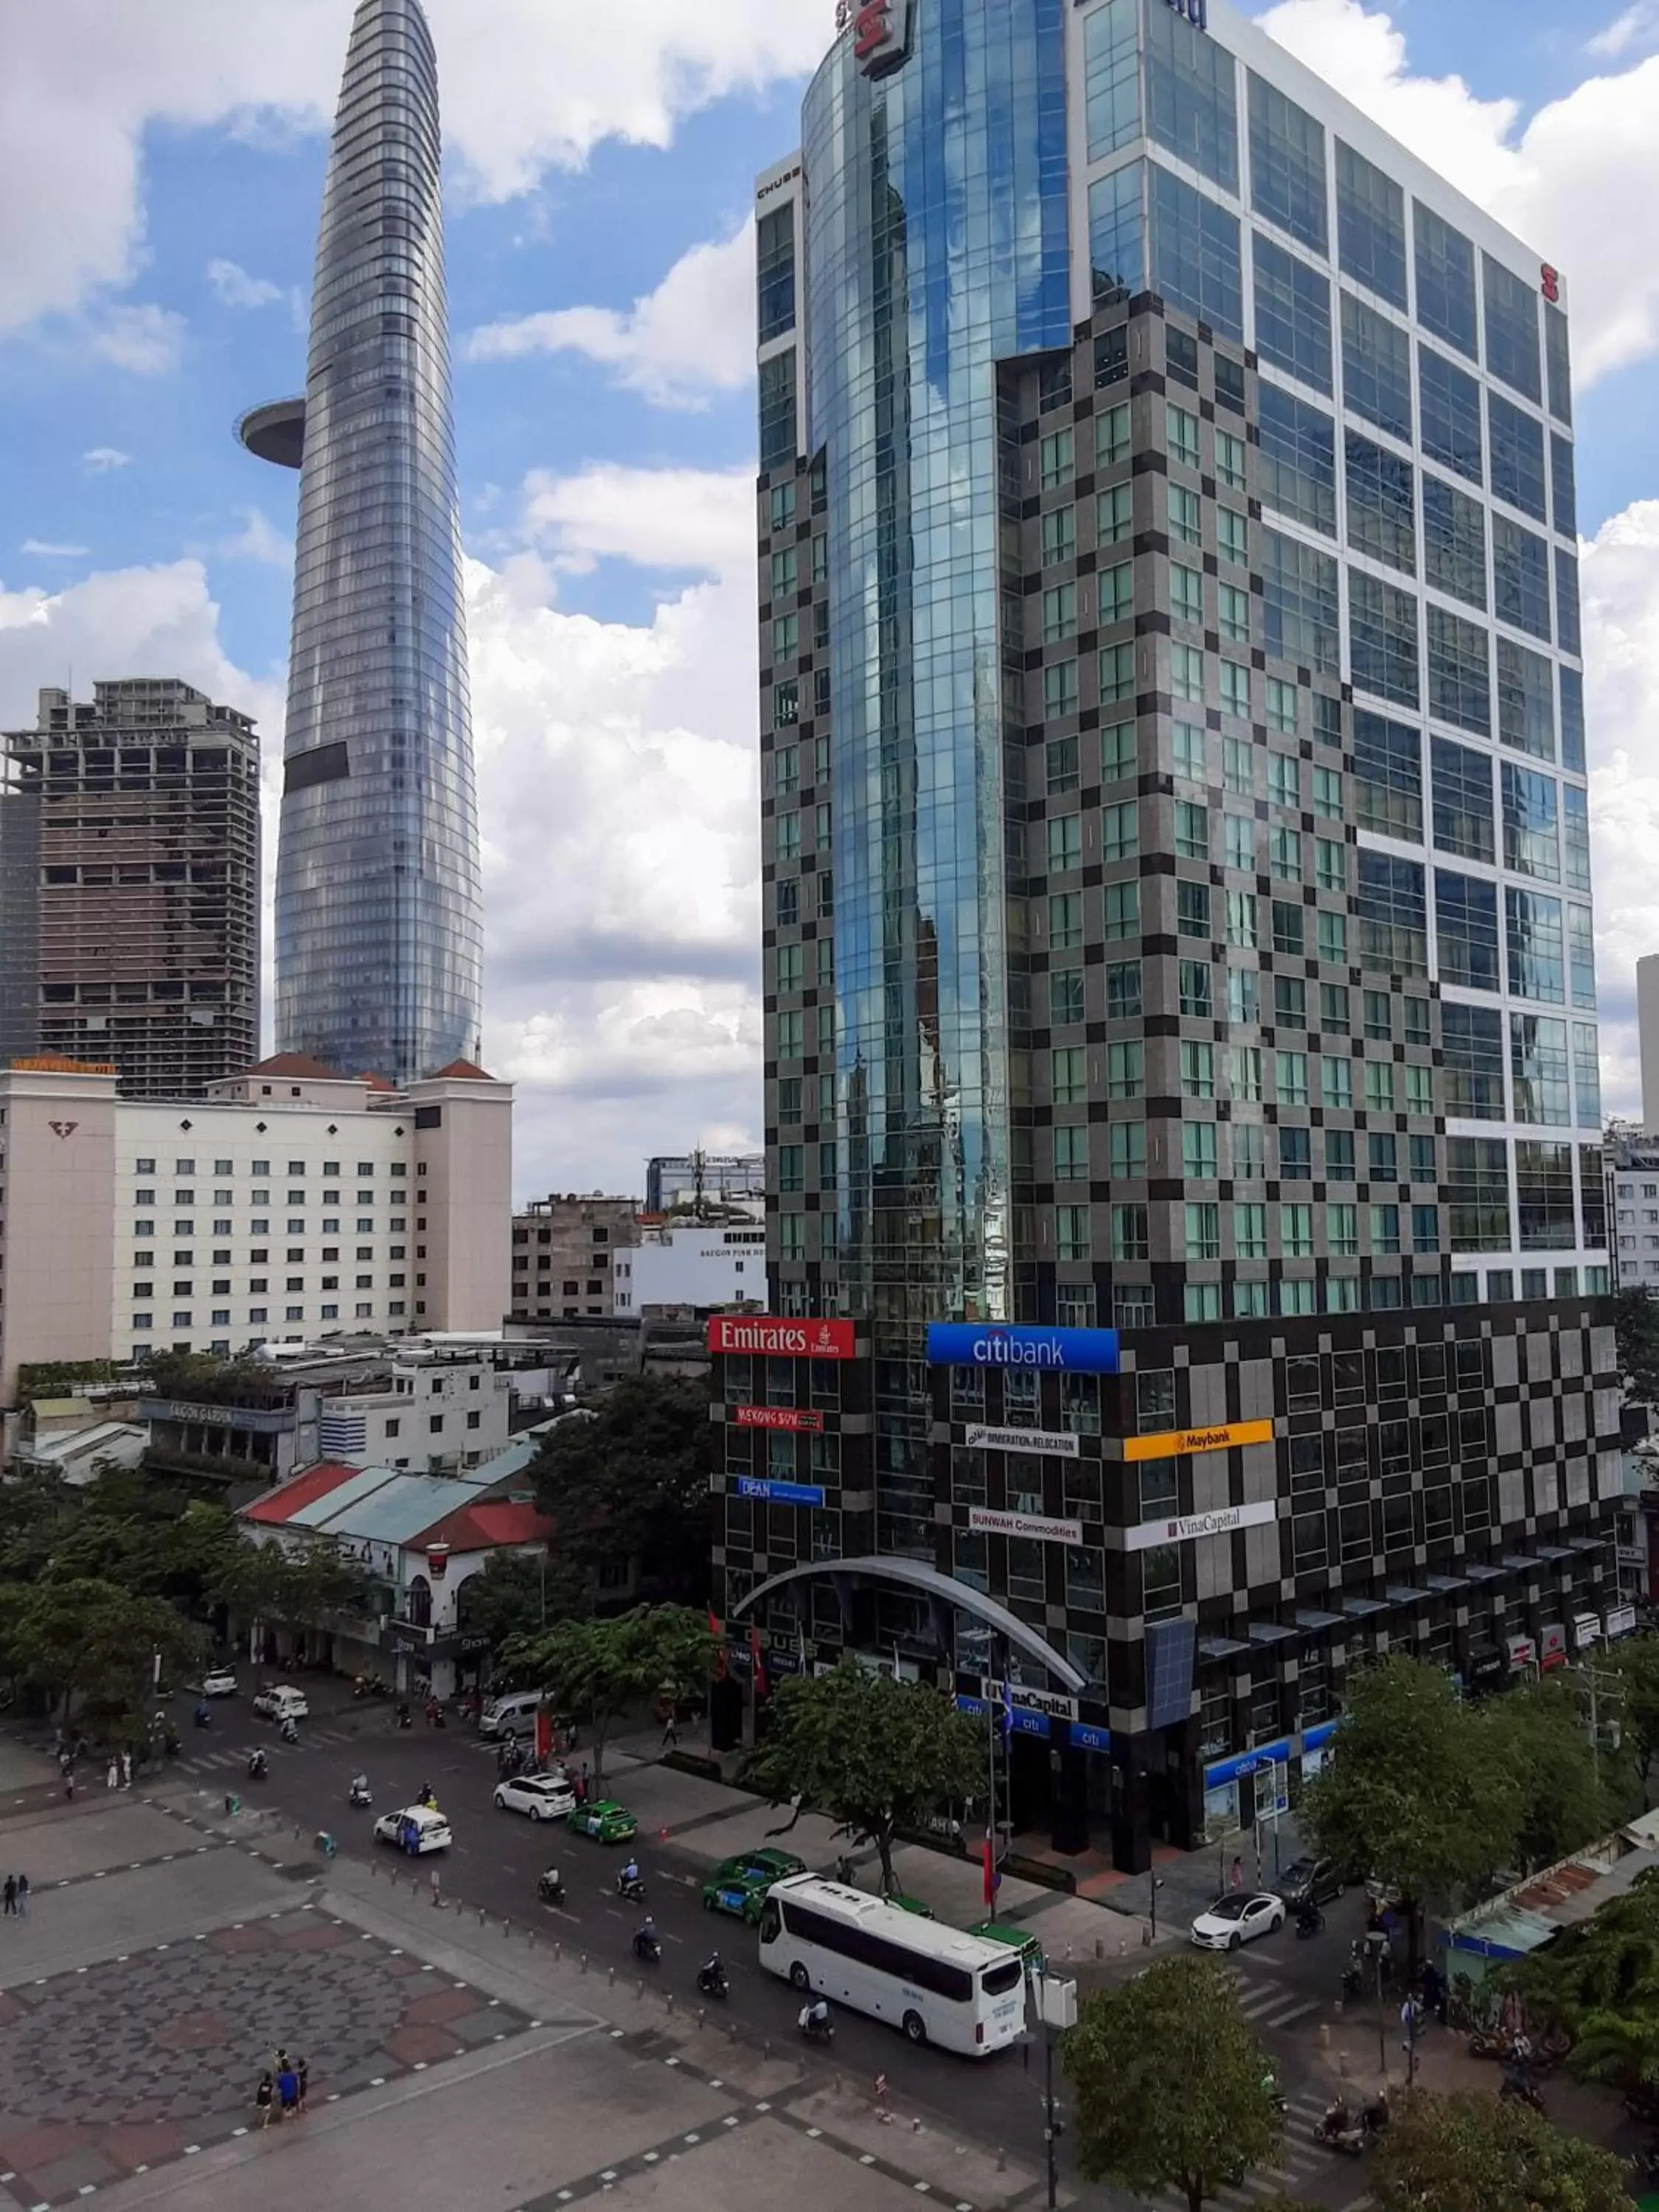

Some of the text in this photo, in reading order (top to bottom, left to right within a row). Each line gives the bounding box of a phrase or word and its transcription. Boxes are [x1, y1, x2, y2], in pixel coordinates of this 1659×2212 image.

[721, 1321, 807, 1352] Emirates
[973, 1334, 1065, 1366] citibank
[1186, 1430, 1231, 1449] Maybank
[972, 1513, 1077, 1539] SUNWAH Commodities
[1179, 1508, 1240, 1536] VinaCapital
[1023, 1717, 1040, 1731] citi
[1082, 1731, 1099, 1746] citi
